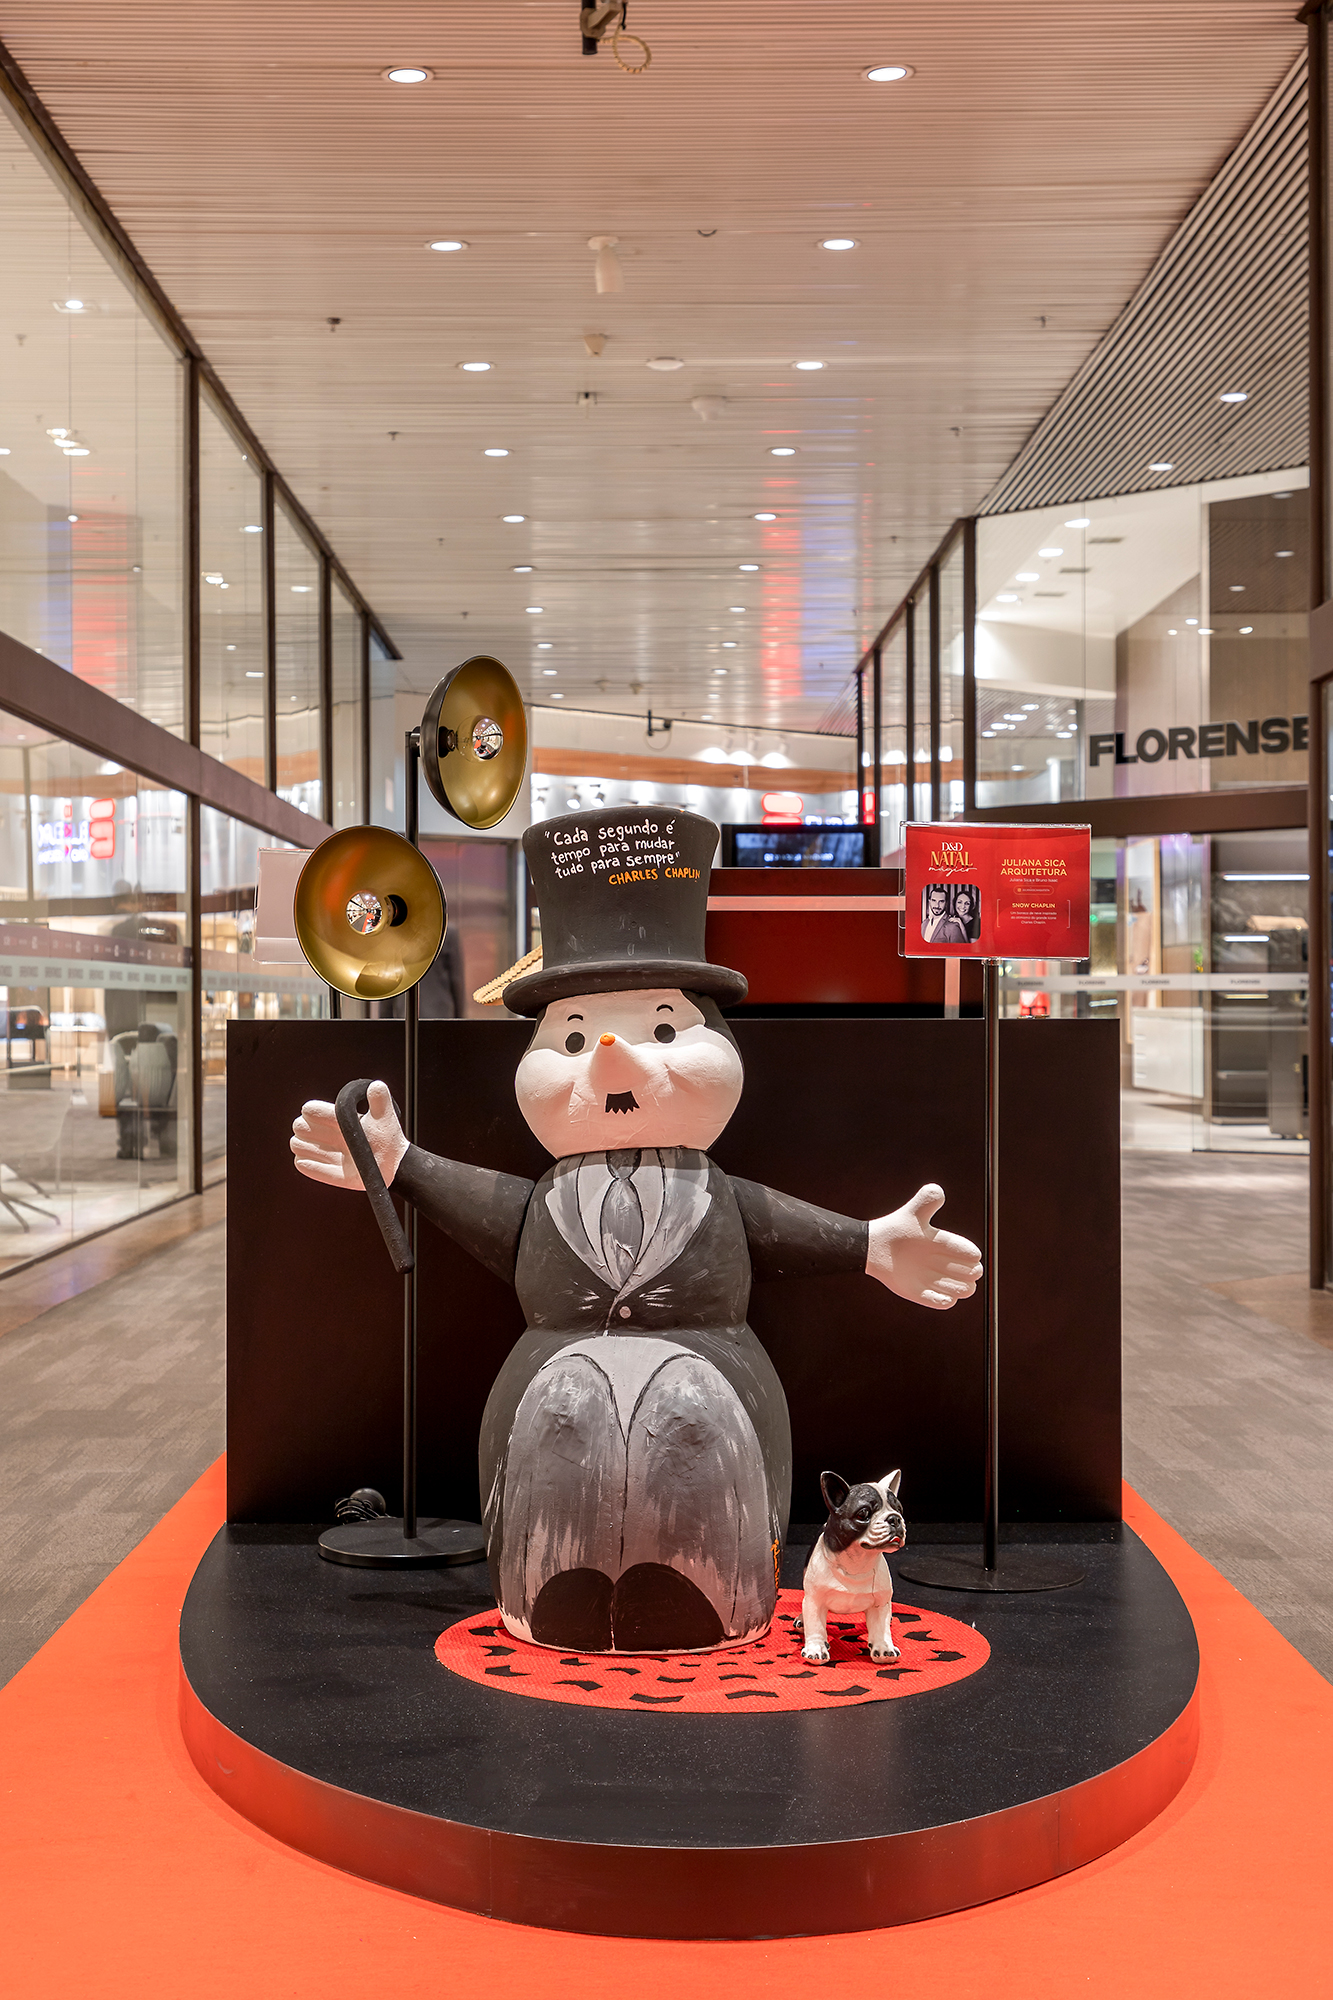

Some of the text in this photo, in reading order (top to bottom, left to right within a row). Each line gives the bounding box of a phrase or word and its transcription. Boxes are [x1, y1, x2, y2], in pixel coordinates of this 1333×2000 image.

[1089, 715, 1309, 767] FLORENSE
[597, 819, 658, 842] segundo
[665, 819, 676, 835] é
[551, 836, 675, 866] tempo para mudar
[941, 842, 963, 851] D&D
[555, 861, 584, 879] tudo
[591, 856, 620, 874] para
[930, 851, 973, 867] NATAL
[1001, 859, 1066, 867] JULIANA SICA
[608, 867, 700, 885] CHARLES CHAPLIN
[1000, 868, 1068, 876] ARQUITETURA
